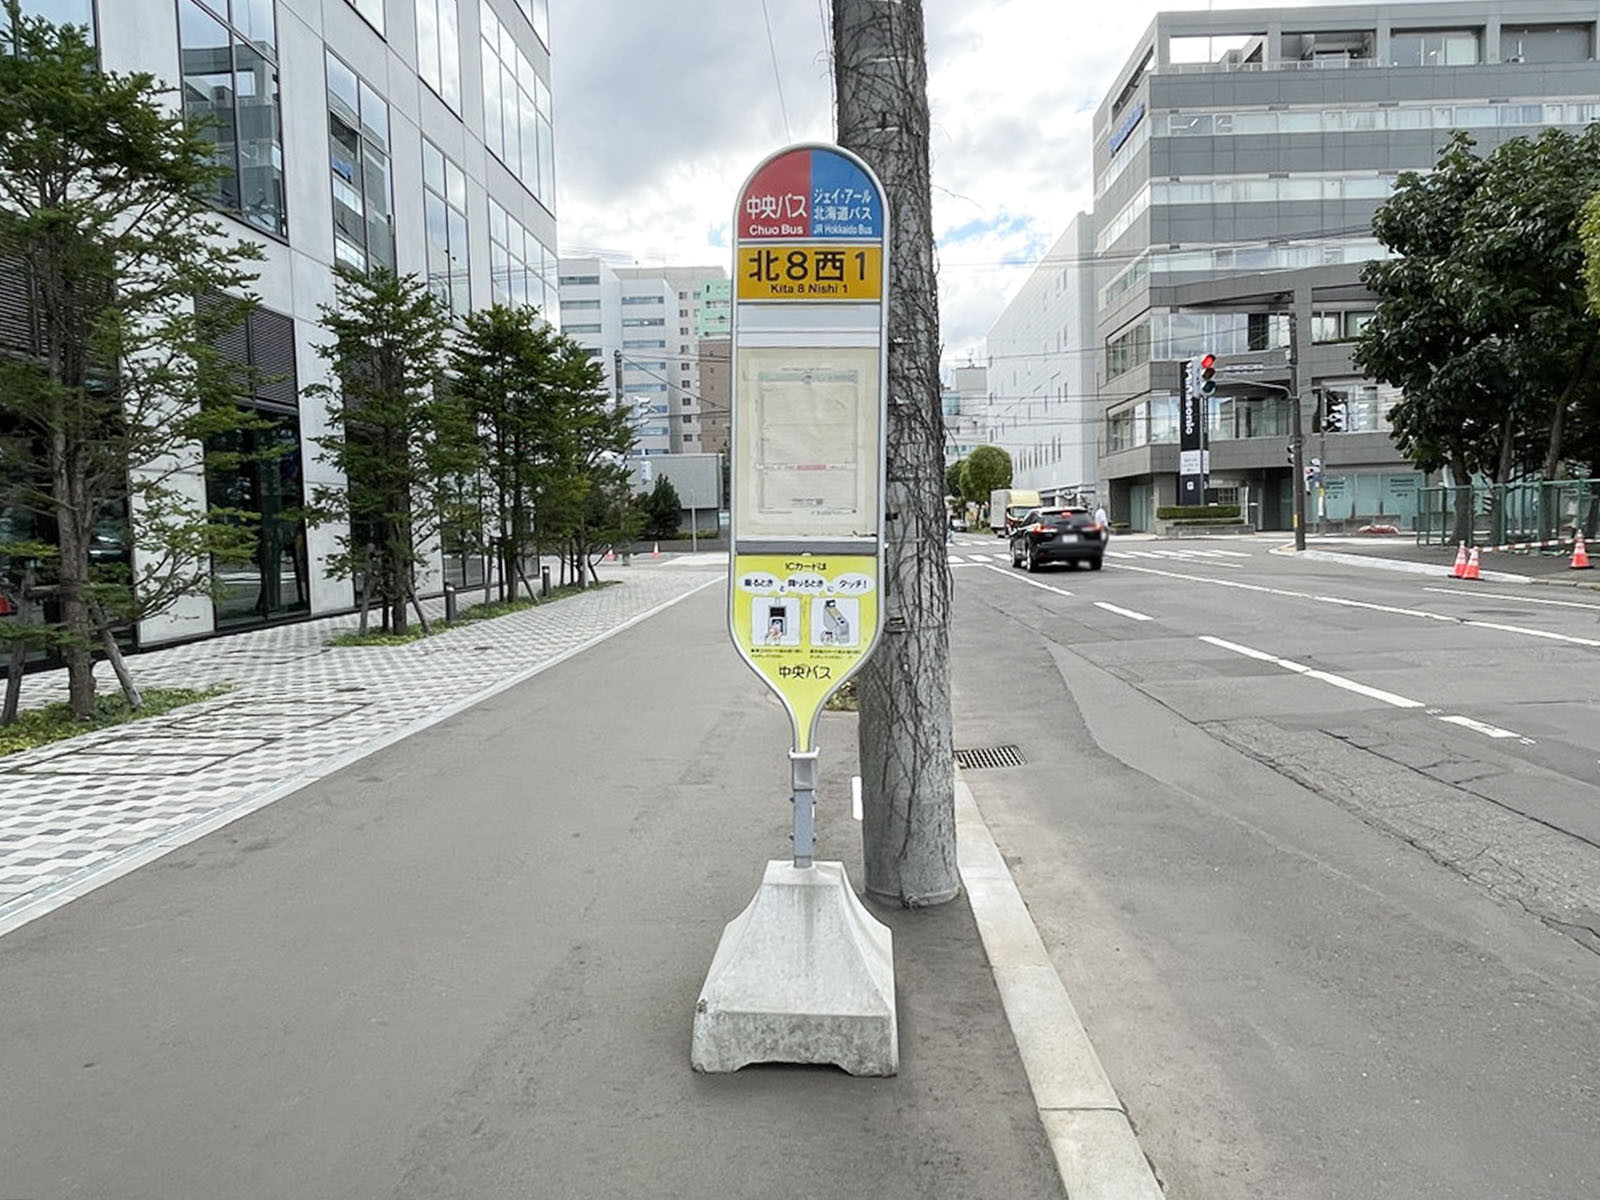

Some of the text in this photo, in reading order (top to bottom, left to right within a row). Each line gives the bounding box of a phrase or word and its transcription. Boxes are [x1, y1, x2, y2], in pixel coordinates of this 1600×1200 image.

[746, 193, 807, 219] 中央バス
[813, 206, 872, 220] 北海道バス
[749, 224, 804, 235] Chuo Bus
[748, 250, 866, 282] 北8西1
[770, 283, 848, 293] Kita 8 Nishi 1
[779, 665, 831, 679] 中央バス
